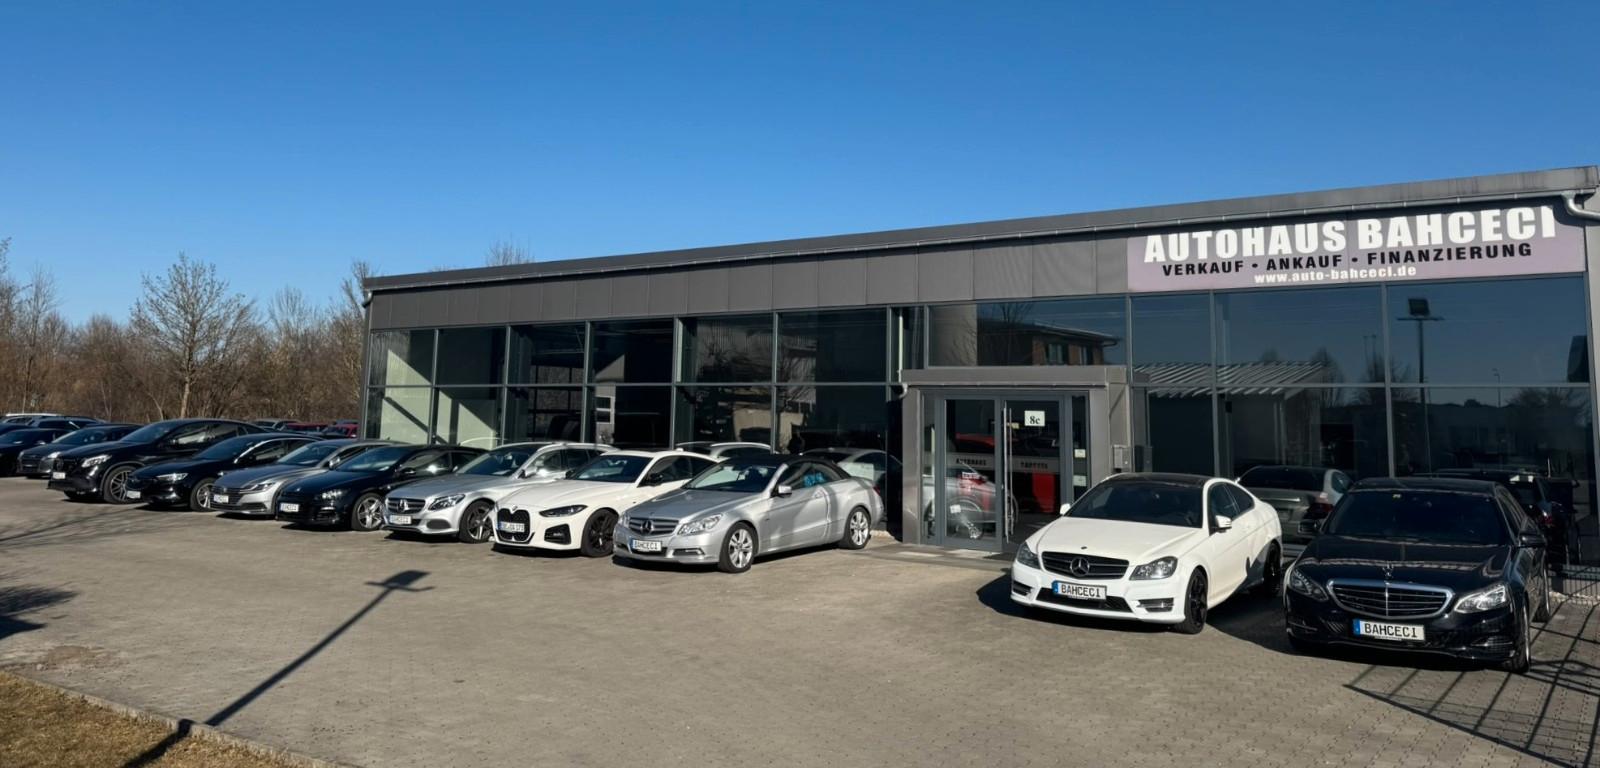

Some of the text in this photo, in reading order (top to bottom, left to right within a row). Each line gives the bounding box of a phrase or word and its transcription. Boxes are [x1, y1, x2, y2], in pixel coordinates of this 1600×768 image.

[1144, 205, 1556, 263] AUTOHAUS BAHCECI
[1162, 242, 1533, 277] VERKAUF ANKAUF FINANZIERUNG
[1253, 265, 1417, 284] www.auto-bahceci.de
[1029, 415, 1041, 425] 8c
[1364, 623, 1417, 638] BAHCECI
